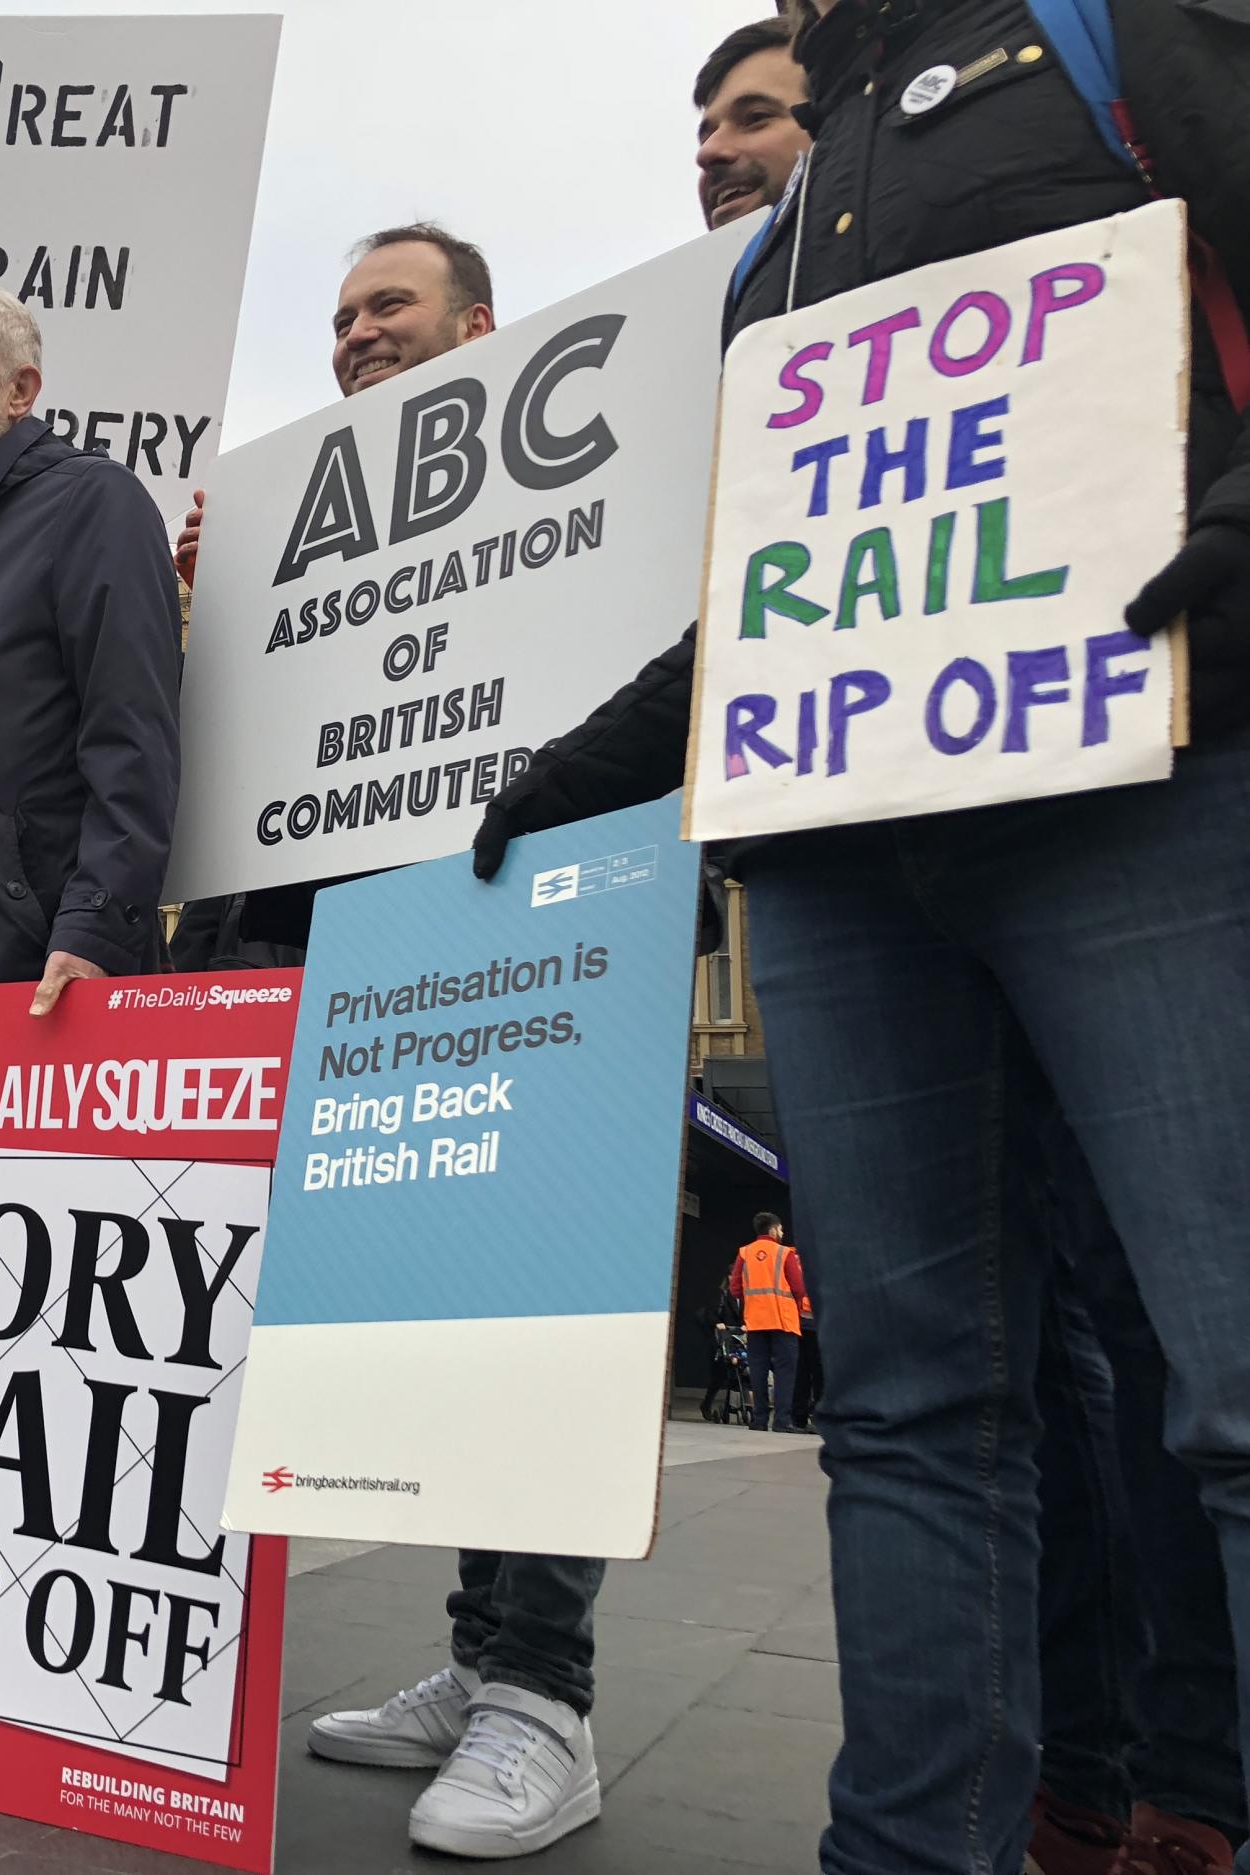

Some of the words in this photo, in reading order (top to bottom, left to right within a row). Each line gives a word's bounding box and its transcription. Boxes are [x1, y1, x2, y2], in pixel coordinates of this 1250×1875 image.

[766, 262, 1106, 428] STOP
[272, 314, 627, 587] ABC
[791, 394, 1010, 517] THE
[265, 498, 605, 654] ASSOCIATION
[738, 496, 1070, 640] RAIL
[383, 622, 449, 682] OF
[316, 677, 505, 768] BRITISH
[724, 669, 892, 781] RIP
[924, 629, 1151, 755] OFF
[256, 745, 540, 847] COMMUTER
[108, 985, 291, 1012] #TheDailySqueeze
[326, 956, 562, 1028] Privatisation
[572, 942, 608, 982] is
[318, 1036, 384, 1081] Not
[391, 1011, 581, 1070] Progress,
[93, 1057, 281, 1134] SQUEEZE
[311, 1093, 403, 1136] Bring
[412, 1072, 514, 1123] Back
[303, 1142, 418, 1191] British
[428, 1130, 499, 1178] Rail
[295, 1474, 420, 1495] bringbackbritishrail.org
[25, 1568, 221, 1706] OFF
[60, 1790, 84, 1807] FOR
[87, 1795, 111, 1814] THE
[113, 1802, 151, 1821] MANY
[154, 1810, 182, 1829] NOT
[185, 1817, 210, 1836] THE
[213, 1823, 242, 1842] FEW
[62, 1767, 165, 1805] REBUILDING
[170, 1790, 244, 1823] BRITAIN
